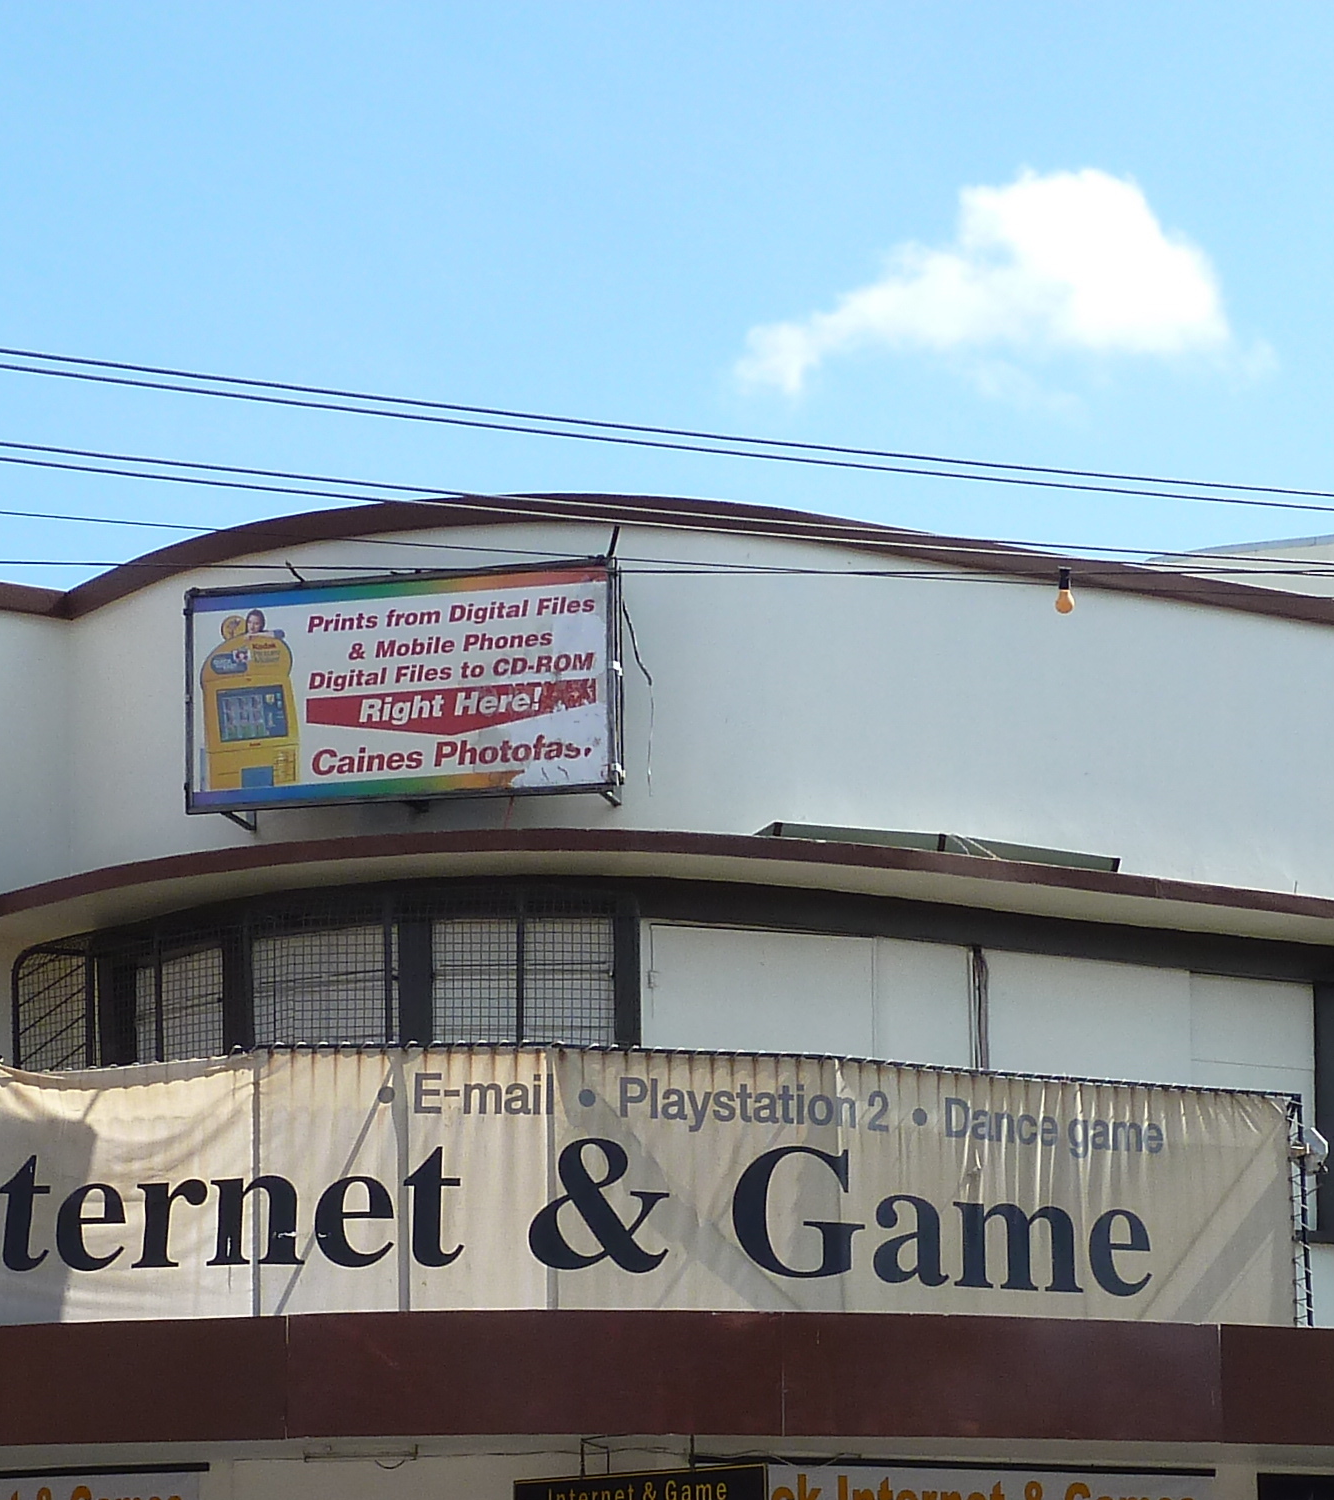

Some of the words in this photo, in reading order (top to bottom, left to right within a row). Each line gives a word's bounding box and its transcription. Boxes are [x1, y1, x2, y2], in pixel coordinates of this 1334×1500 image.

[307, 612, 379, 634] Prints
[386, 608, 444, 628] from
[448, 600, 529, 628] Digital
[536, 596, 595, 617] Files
[348, 642, 366, 661] &
[374, 636, 454, 658] Mobile
[463, 630, 553, 653] Phones
[308, 665, 386, 691] Digital
[395, 663, 452, 685] Files
[460, 661, 486, 679] to
[492, 652, 595, 678] CD-ROM
[358, 694, 444, 728] Right
[454, 687, 543, 715] Here!
[311, 747, 424, 777] Caines
[414, 1073, 555, 1115] E-mail
[619, 1077, 857, 1133] Playstation
[866, 1090, 890, 1132] 2
[944, 1097, 1060, 1148] Dance
[1069, 1116, 1165, 1159] game
[528, 1137, 670, 1274] &
[733, 1147, 1153, 1298] Game
